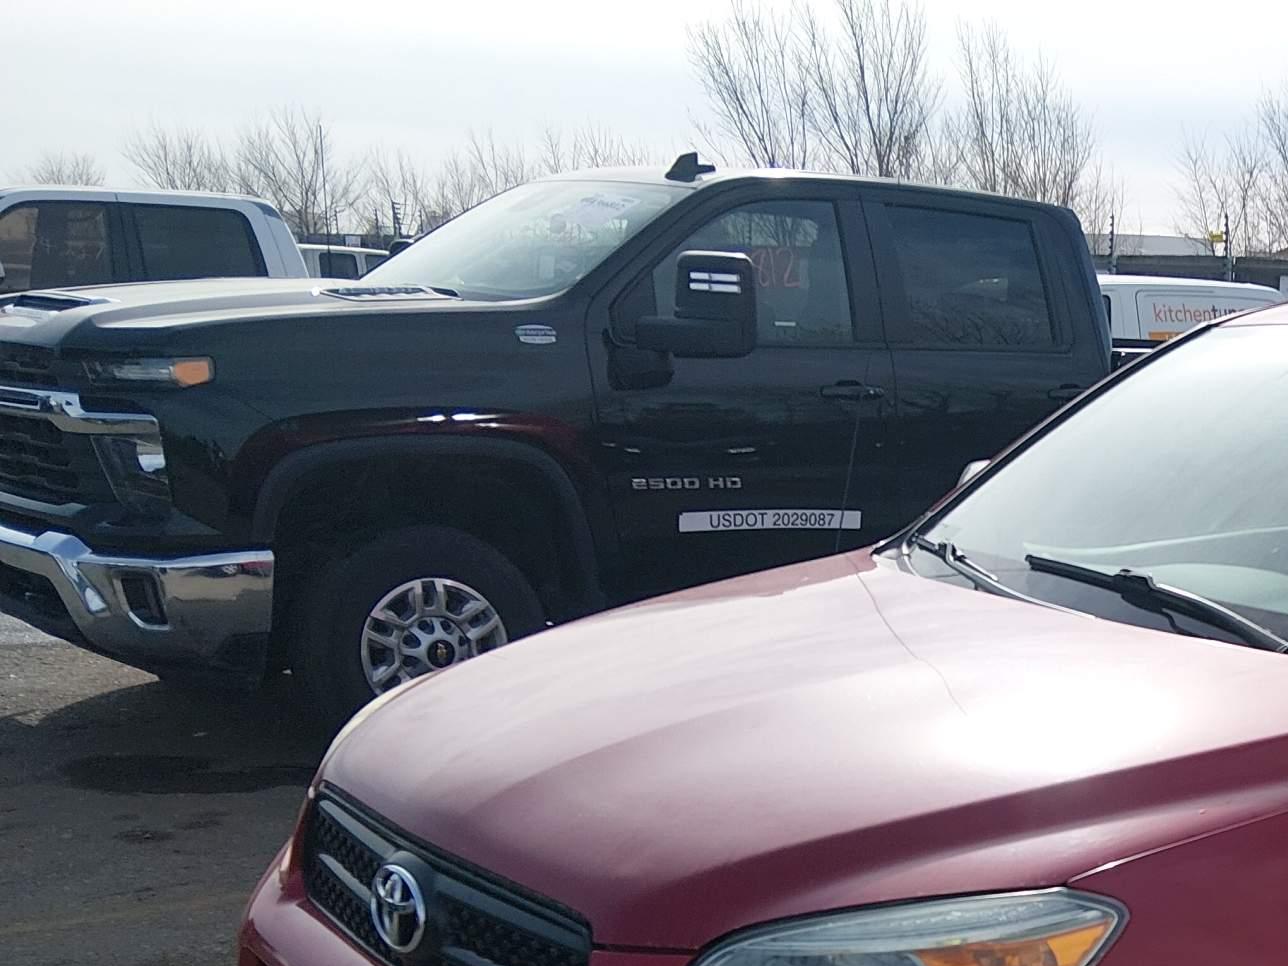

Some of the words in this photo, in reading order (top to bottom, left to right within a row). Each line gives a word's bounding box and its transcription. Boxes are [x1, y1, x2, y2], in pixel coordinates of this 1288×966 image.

[1152, 303, 1245, 323] kitchentu
[631, 478, 700, 490] 2500
[708, 477, 742, 489] HD
[709, 512, 768, 529] USDOT
[772, 512, 835, 527] 2029087
